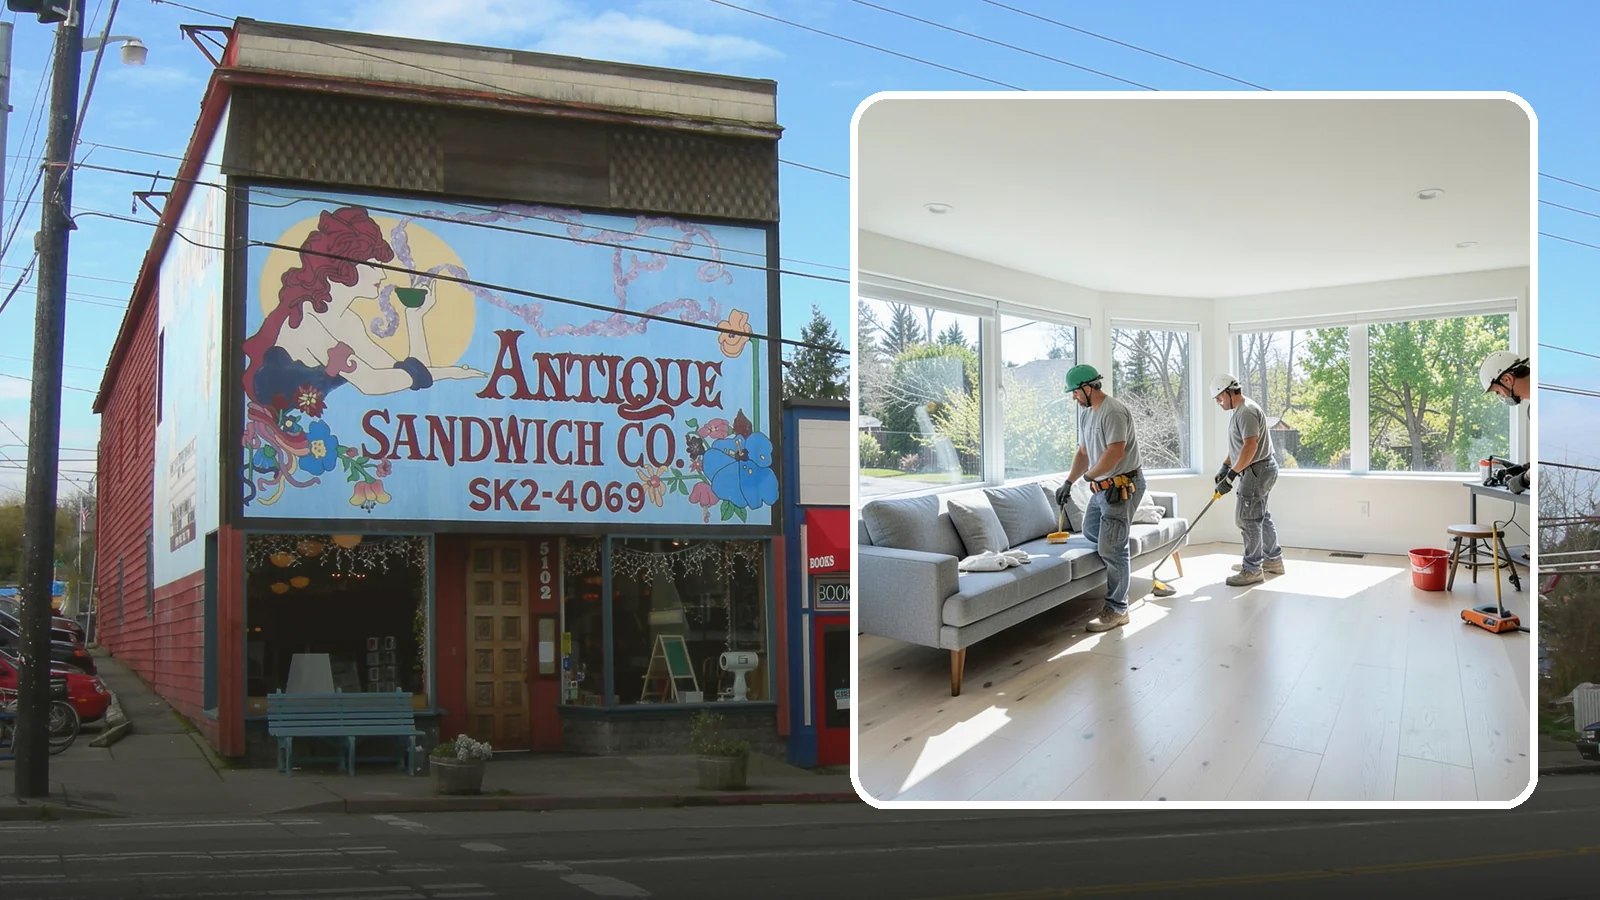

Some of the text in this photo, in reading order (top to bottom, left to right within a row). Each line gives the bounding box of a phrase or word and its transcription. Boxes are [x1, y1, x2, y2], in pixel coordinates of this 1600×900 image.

[476, 329, 723, 420] ANTIQUE
[361, 409, 684, 468] SANDWICH CO.
[468, 477, 646, 513] SK2-4069
[540, 541, 551, 600] 5102
[809, 555, 835, 569] BOOKS
